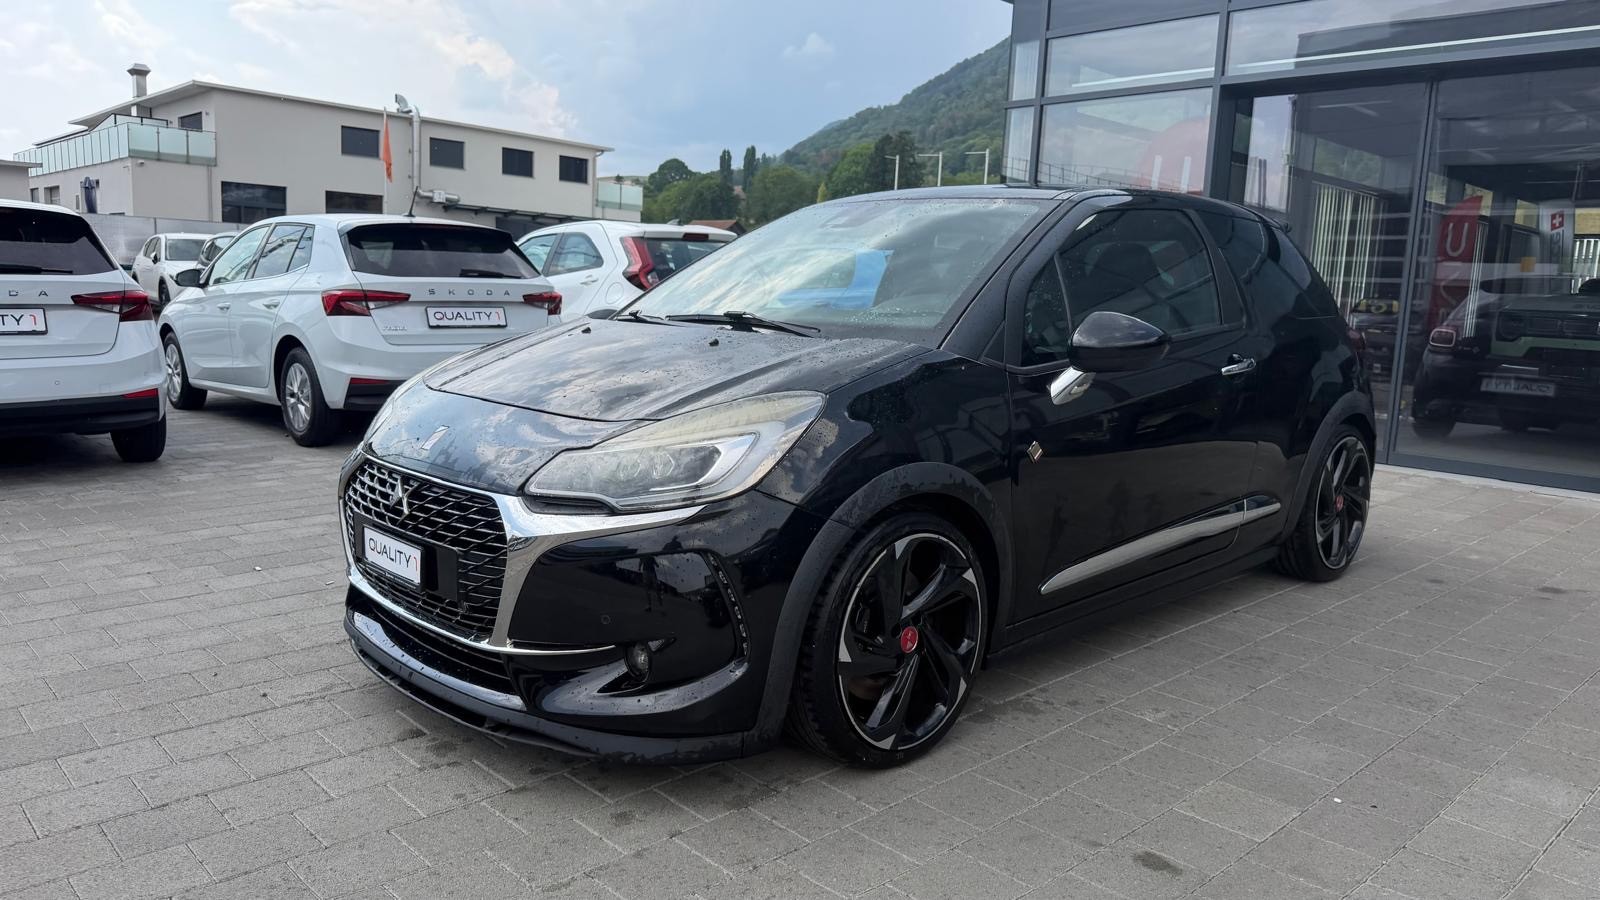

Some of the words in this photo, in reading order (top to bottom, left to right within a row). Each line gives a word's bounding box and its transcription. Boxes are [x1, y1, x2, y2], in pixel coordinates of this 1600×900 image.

[29, 314, 37, 325] 1
[433, 311, 492, 321] QUALITY
[495, 311, 501, 321] 1
[368, 537, 412, 568] QUALITY
[413, 556, 418, 572] 1
